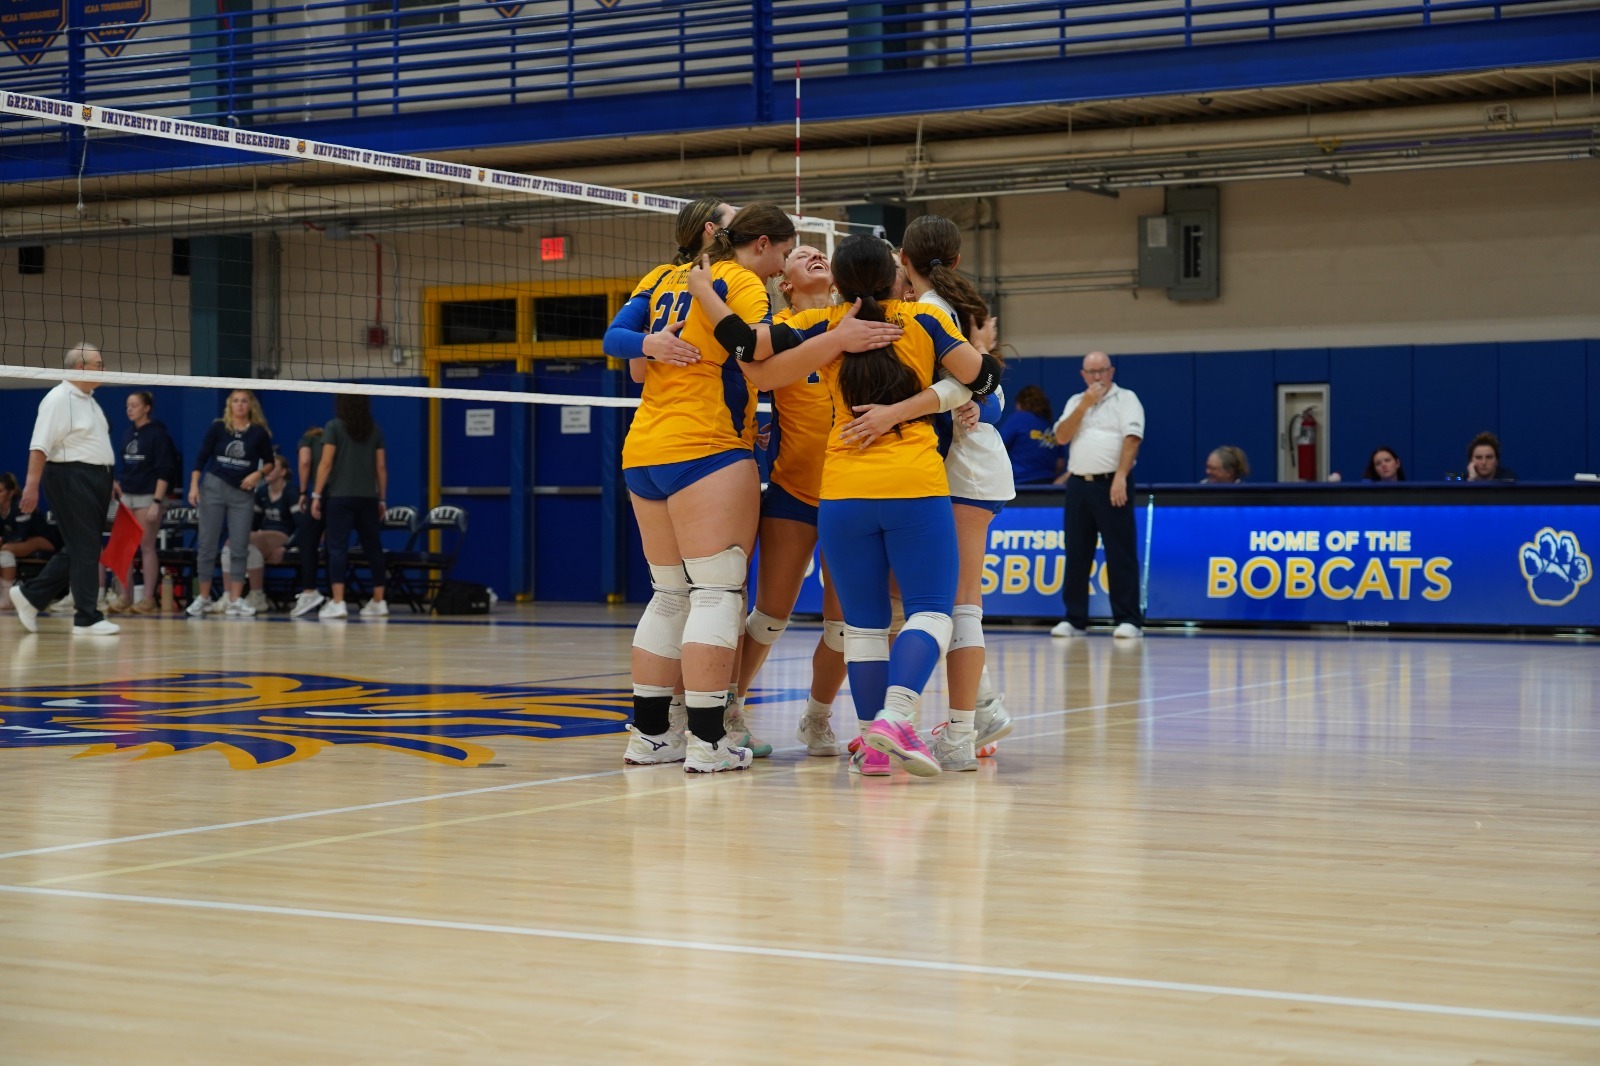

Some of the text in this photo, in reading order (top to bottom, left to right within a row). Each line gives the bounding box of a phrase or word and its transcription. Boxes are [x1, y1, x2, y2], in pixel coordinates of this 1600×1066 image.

[6, 94, 73, 117] GREENSBURG
[101, 110, 290, 150] UNIVERSITY OF PITTSBURGH GREENSBURG
[313, 143, 472, 179] UNIVERSITY OF PITTSBURGH GREENSBURG
[492, 172, 531, 188] UNIVERSITY
[532, 179, 541, 189] OF
[1249, 530, 1411, 552] HOME OF THE
[1207, 555, 1453, 602] BOBCATS
